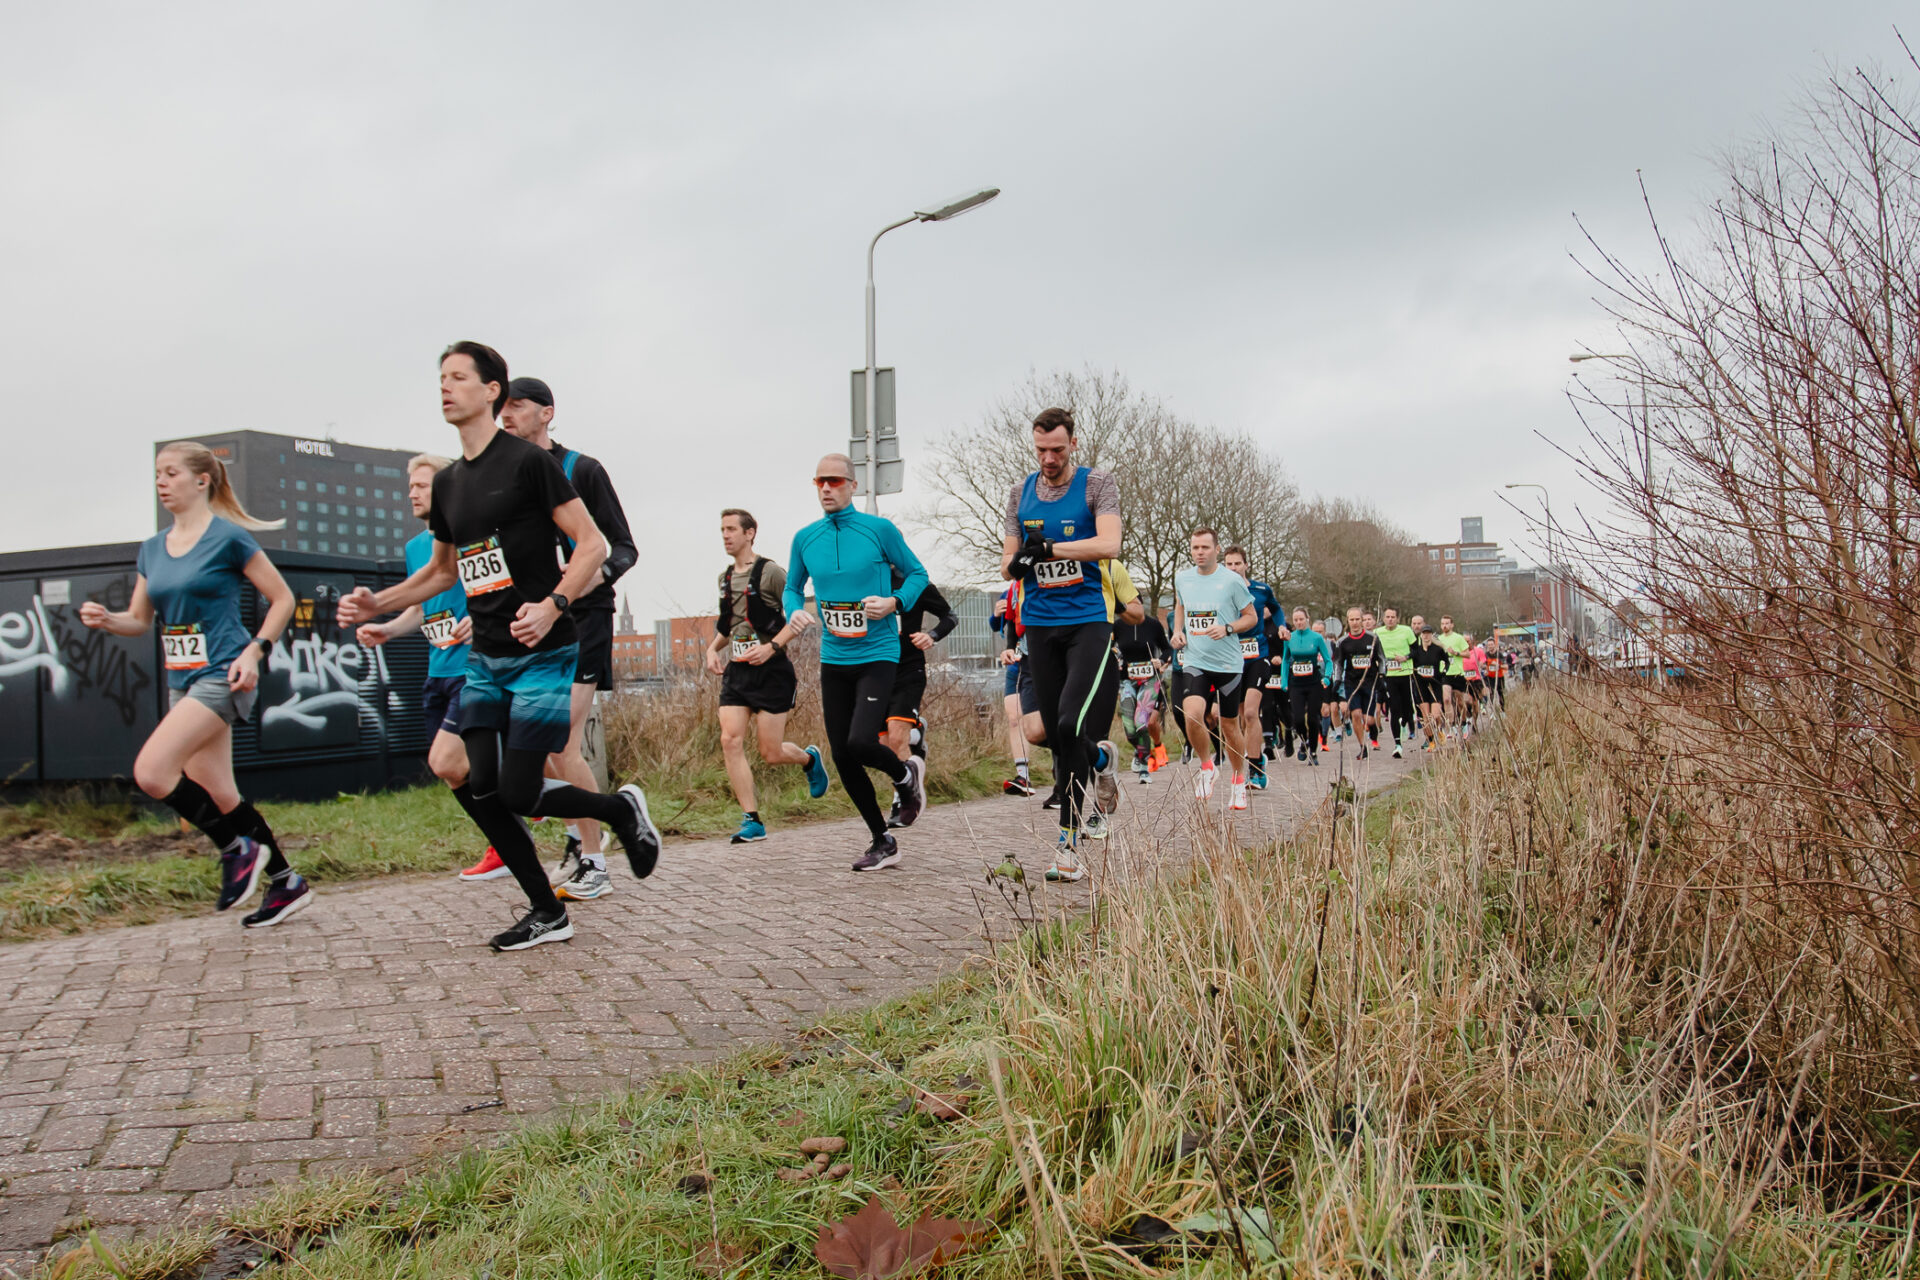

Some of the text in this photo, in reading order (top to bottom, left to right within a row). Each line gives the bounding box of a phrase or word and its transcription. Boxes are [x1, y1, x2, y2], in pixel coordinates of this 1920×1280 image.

[294, 439, 335, 457] HOTEL
[460, 552, 502, 582] 2236
[1037, 560, 1078, 579] 4128
[824, 611, 864, 628] 2158
[1189, 618, 1215, 629] 4167
[424, 620, 453, 641] 2172
[164, 636, 201, 657] 2212
[1129, 666, 1152, 676] 4143
